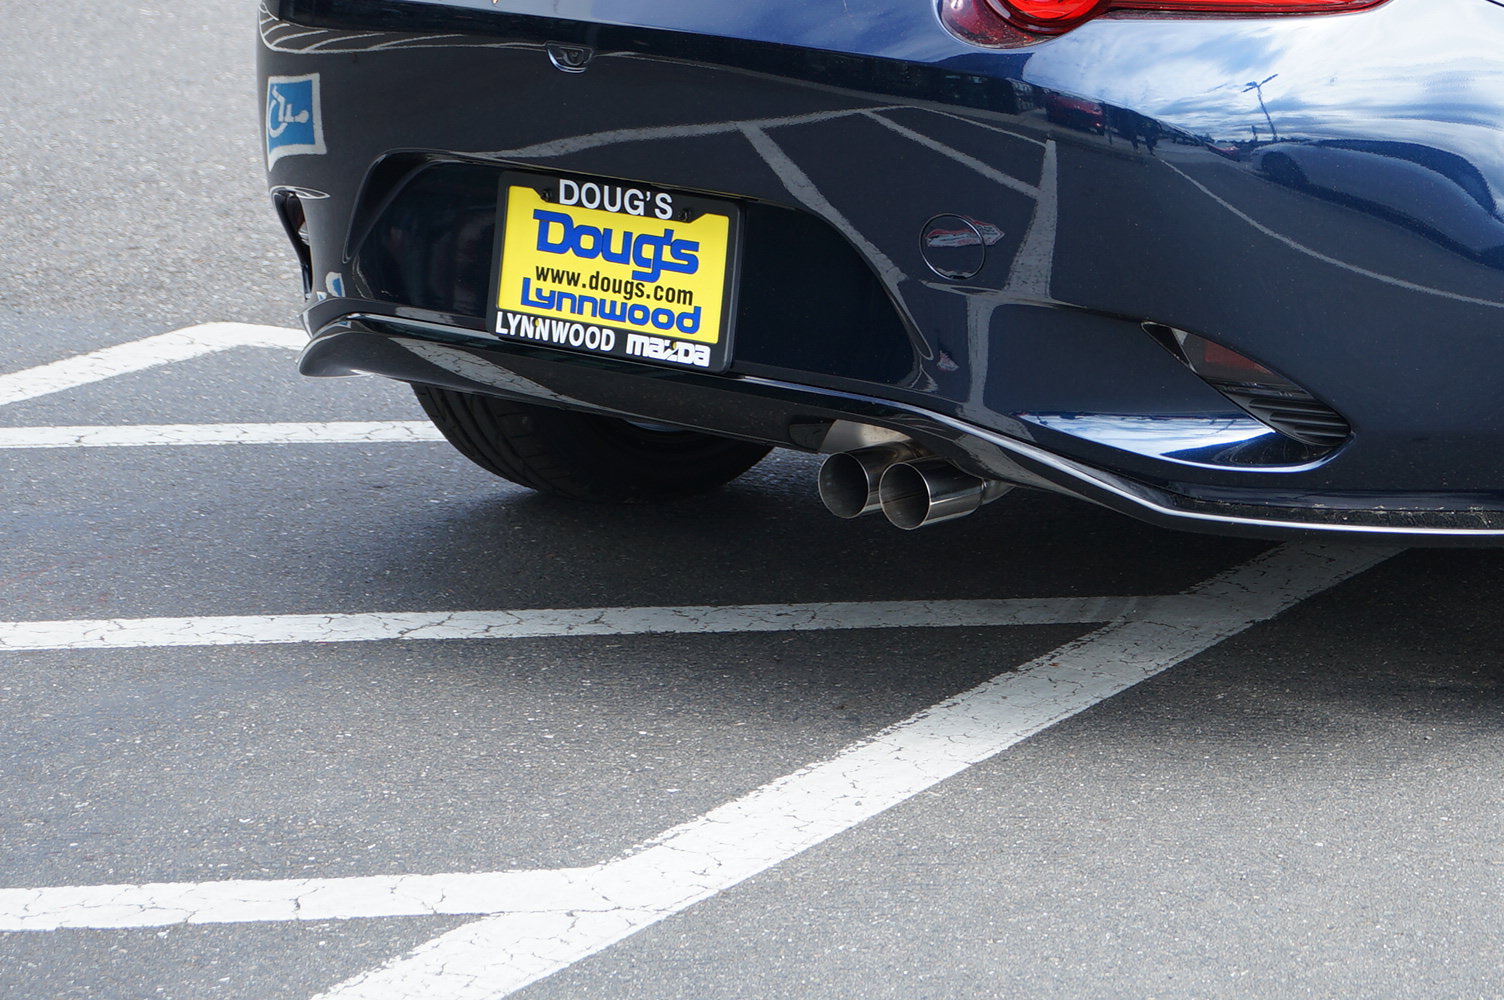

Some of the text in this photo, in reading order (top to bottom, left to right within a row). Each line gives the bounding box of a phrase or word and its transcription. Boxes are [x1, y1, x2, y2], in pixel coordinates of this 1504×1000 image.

[559, 179, 673, 220] DOUG'S
[533, 209, 700, 283] Doug's
[521, 277, 702, 335] Lynnwood
[535, 266, 694, 306] www.dougs.com
[495, 311, 615, 351] LYNNWOOD
